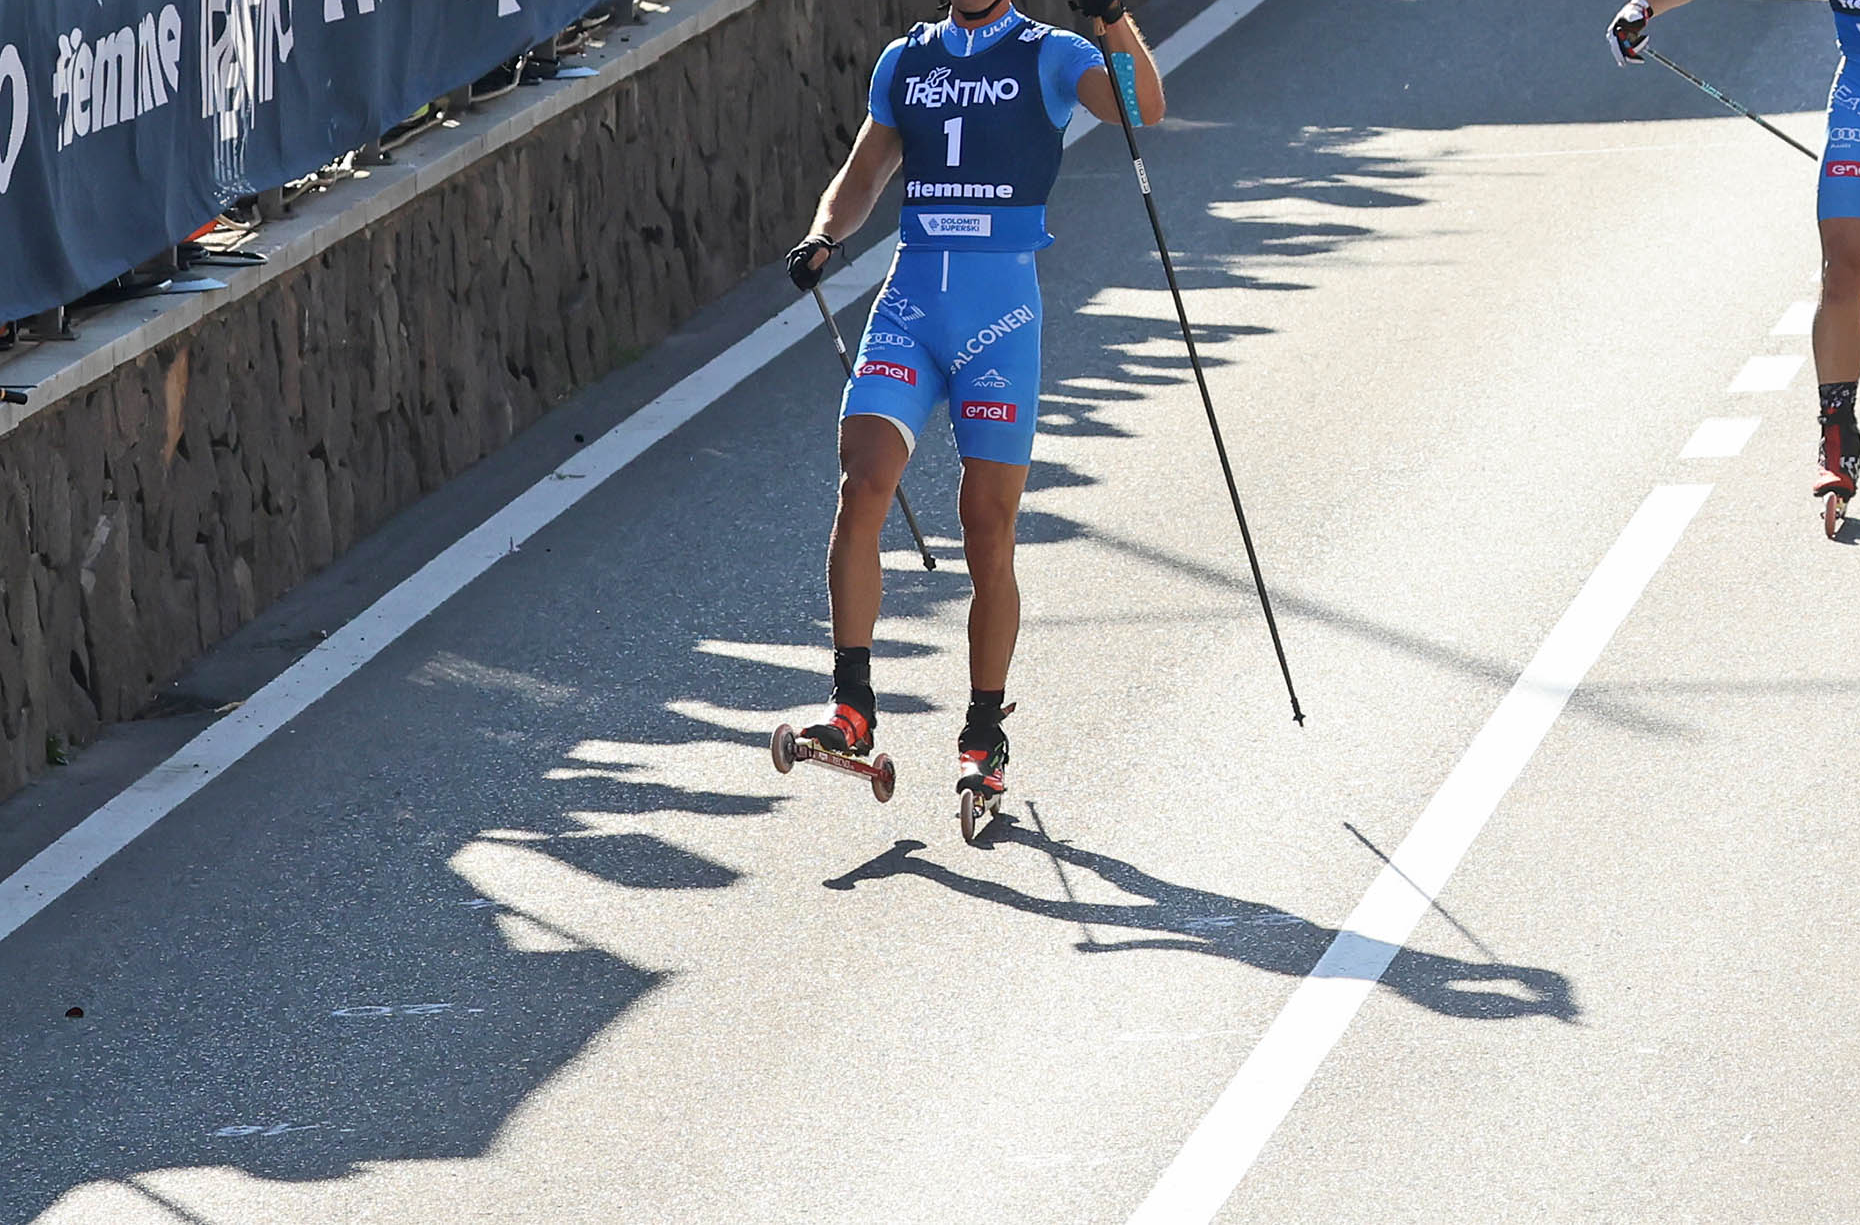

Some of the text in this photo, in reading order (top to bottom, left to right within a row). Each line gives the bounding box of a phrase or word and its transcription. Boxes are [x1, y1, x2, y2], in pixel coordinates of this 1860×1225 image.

[904, 76, 1020, 109] TRENTINO
[943, 116, 963, 167] 1
[906, 181, 1014, 199] fiemme
[940, 224, 981, 232] SUPERSKI
[862, 364, 909, 382] enel
[974, 379, 1006, 388] AVIO
[965, 404, 1009, 420] enel
